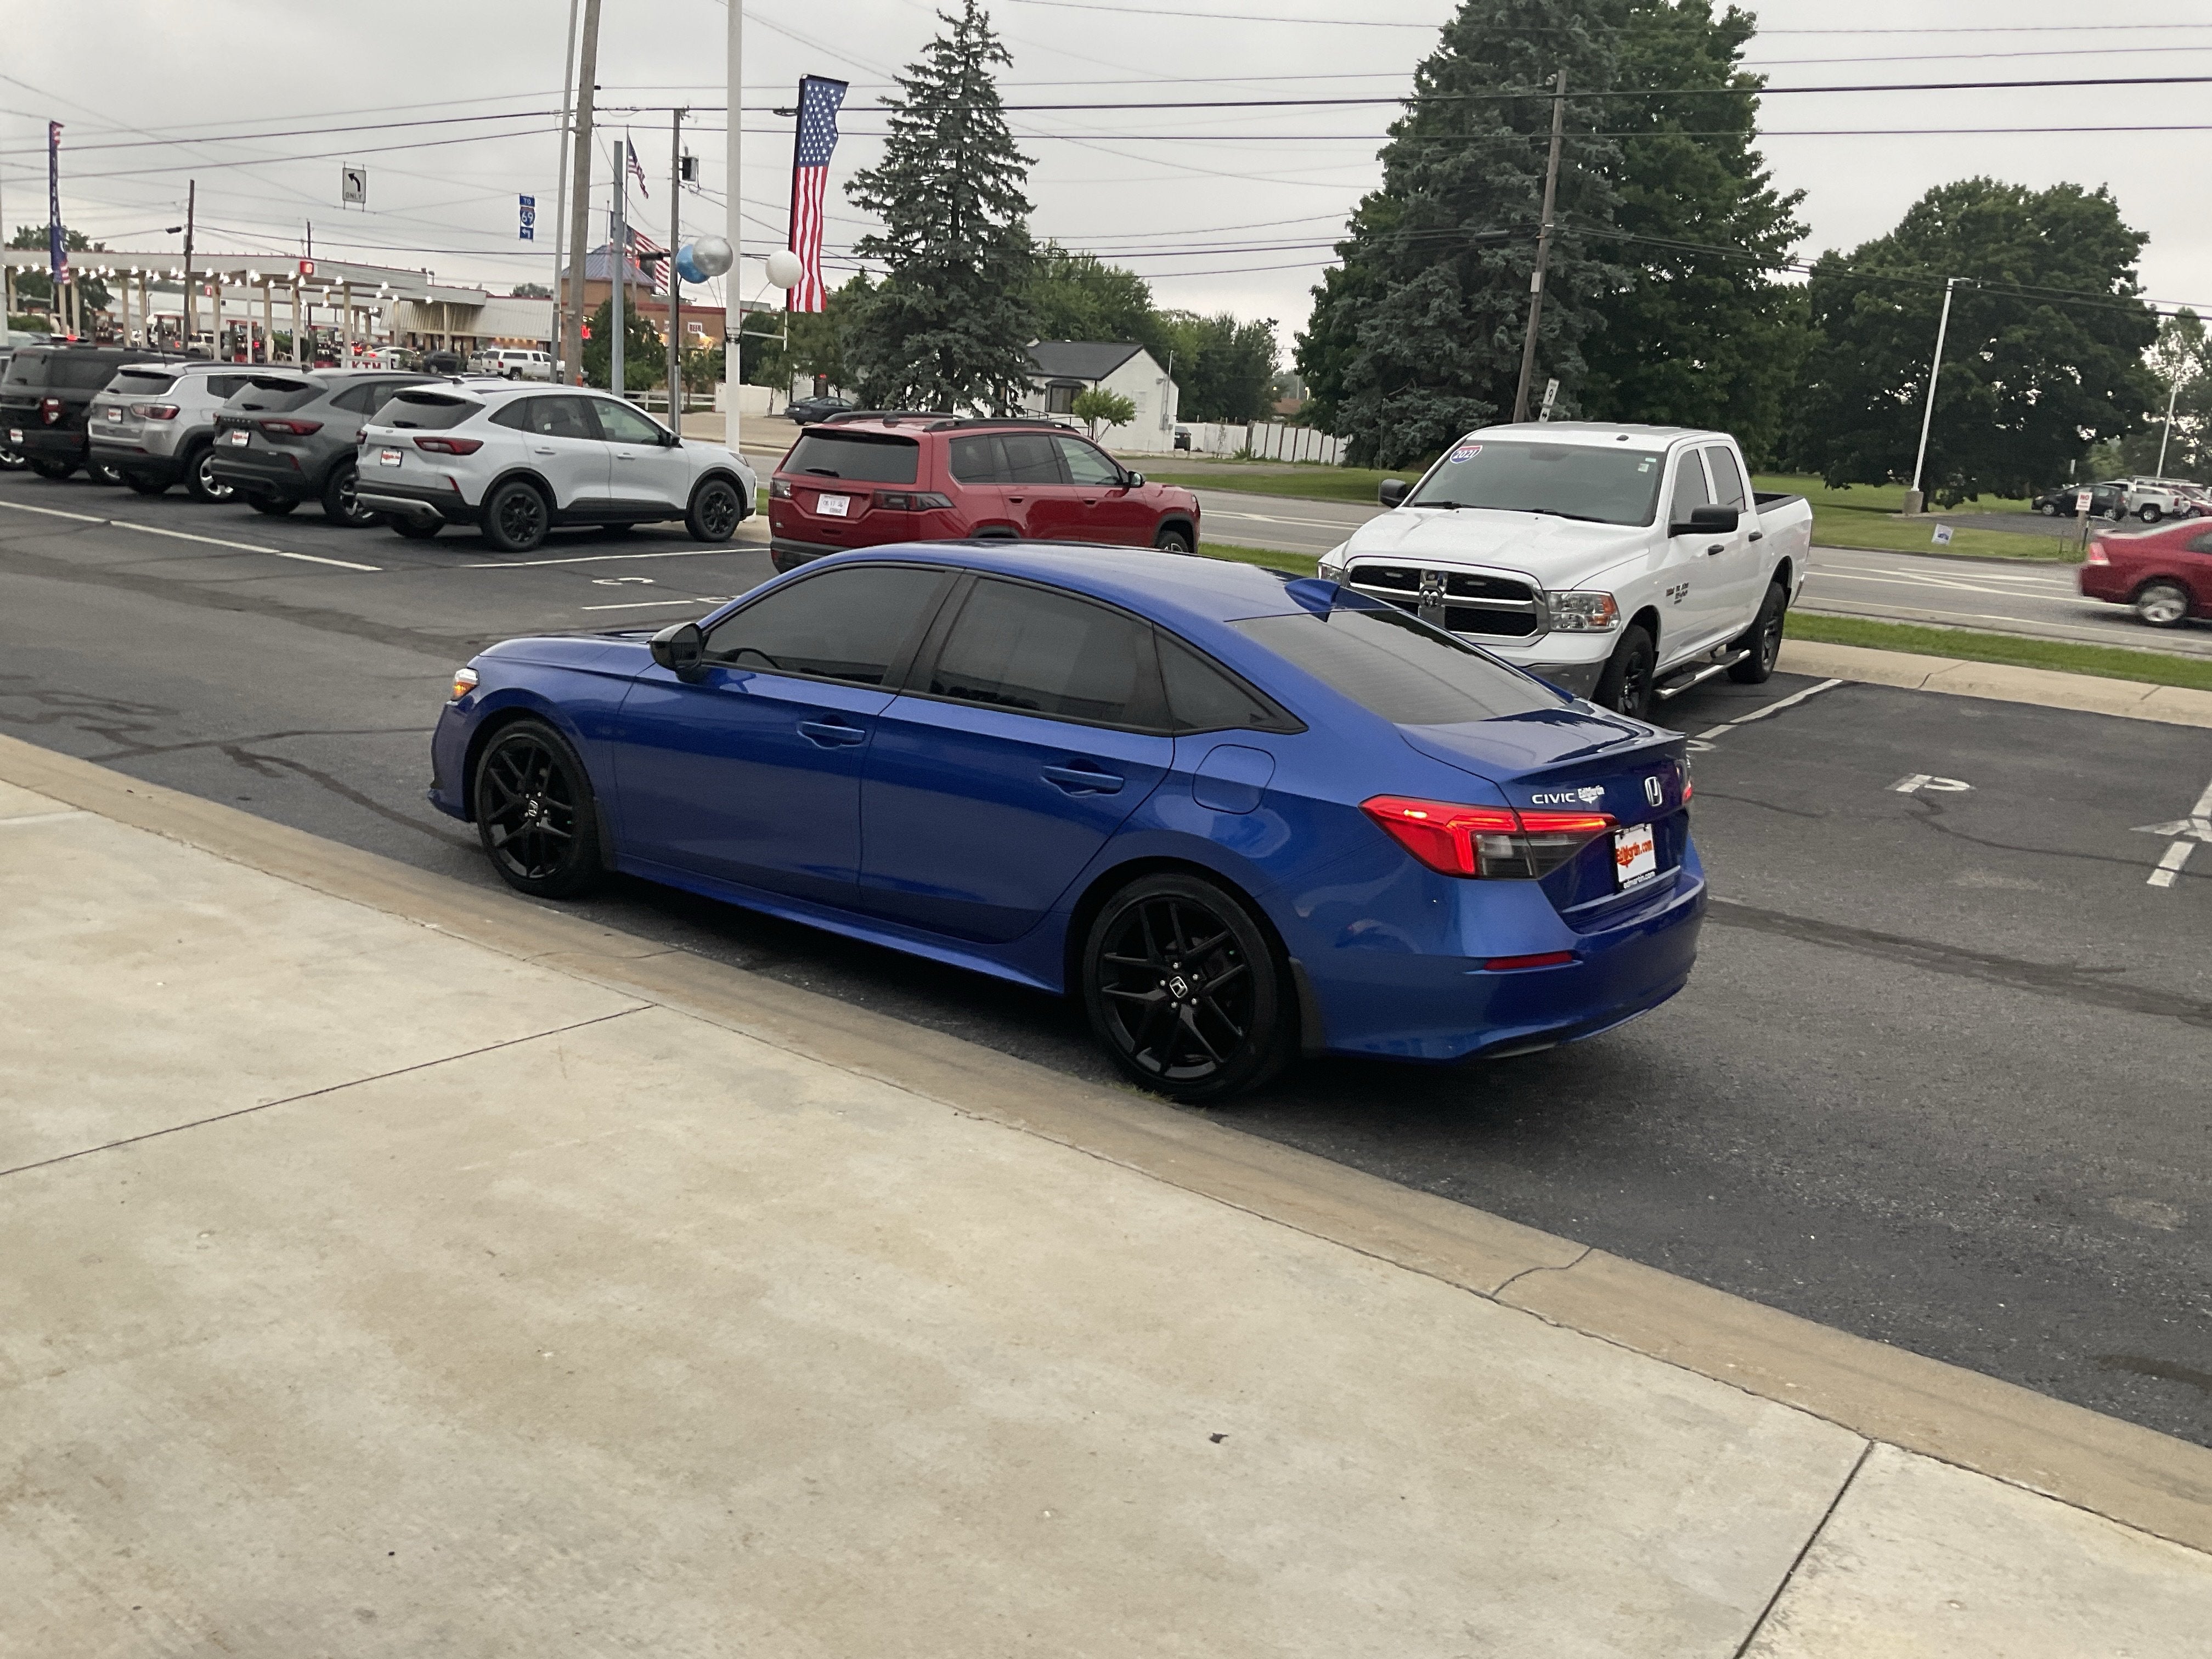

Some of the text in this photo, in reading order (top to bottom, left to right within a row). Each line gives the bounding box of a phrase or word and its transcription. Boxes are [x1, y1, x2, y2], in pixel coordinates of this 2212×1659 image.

[521, 211, 534, 223] 69
[1549, 388, 1554, 402] 9
[1452, 449, 1478, 459] 2021
[1532, 793, 1576, 804] CIVIC
